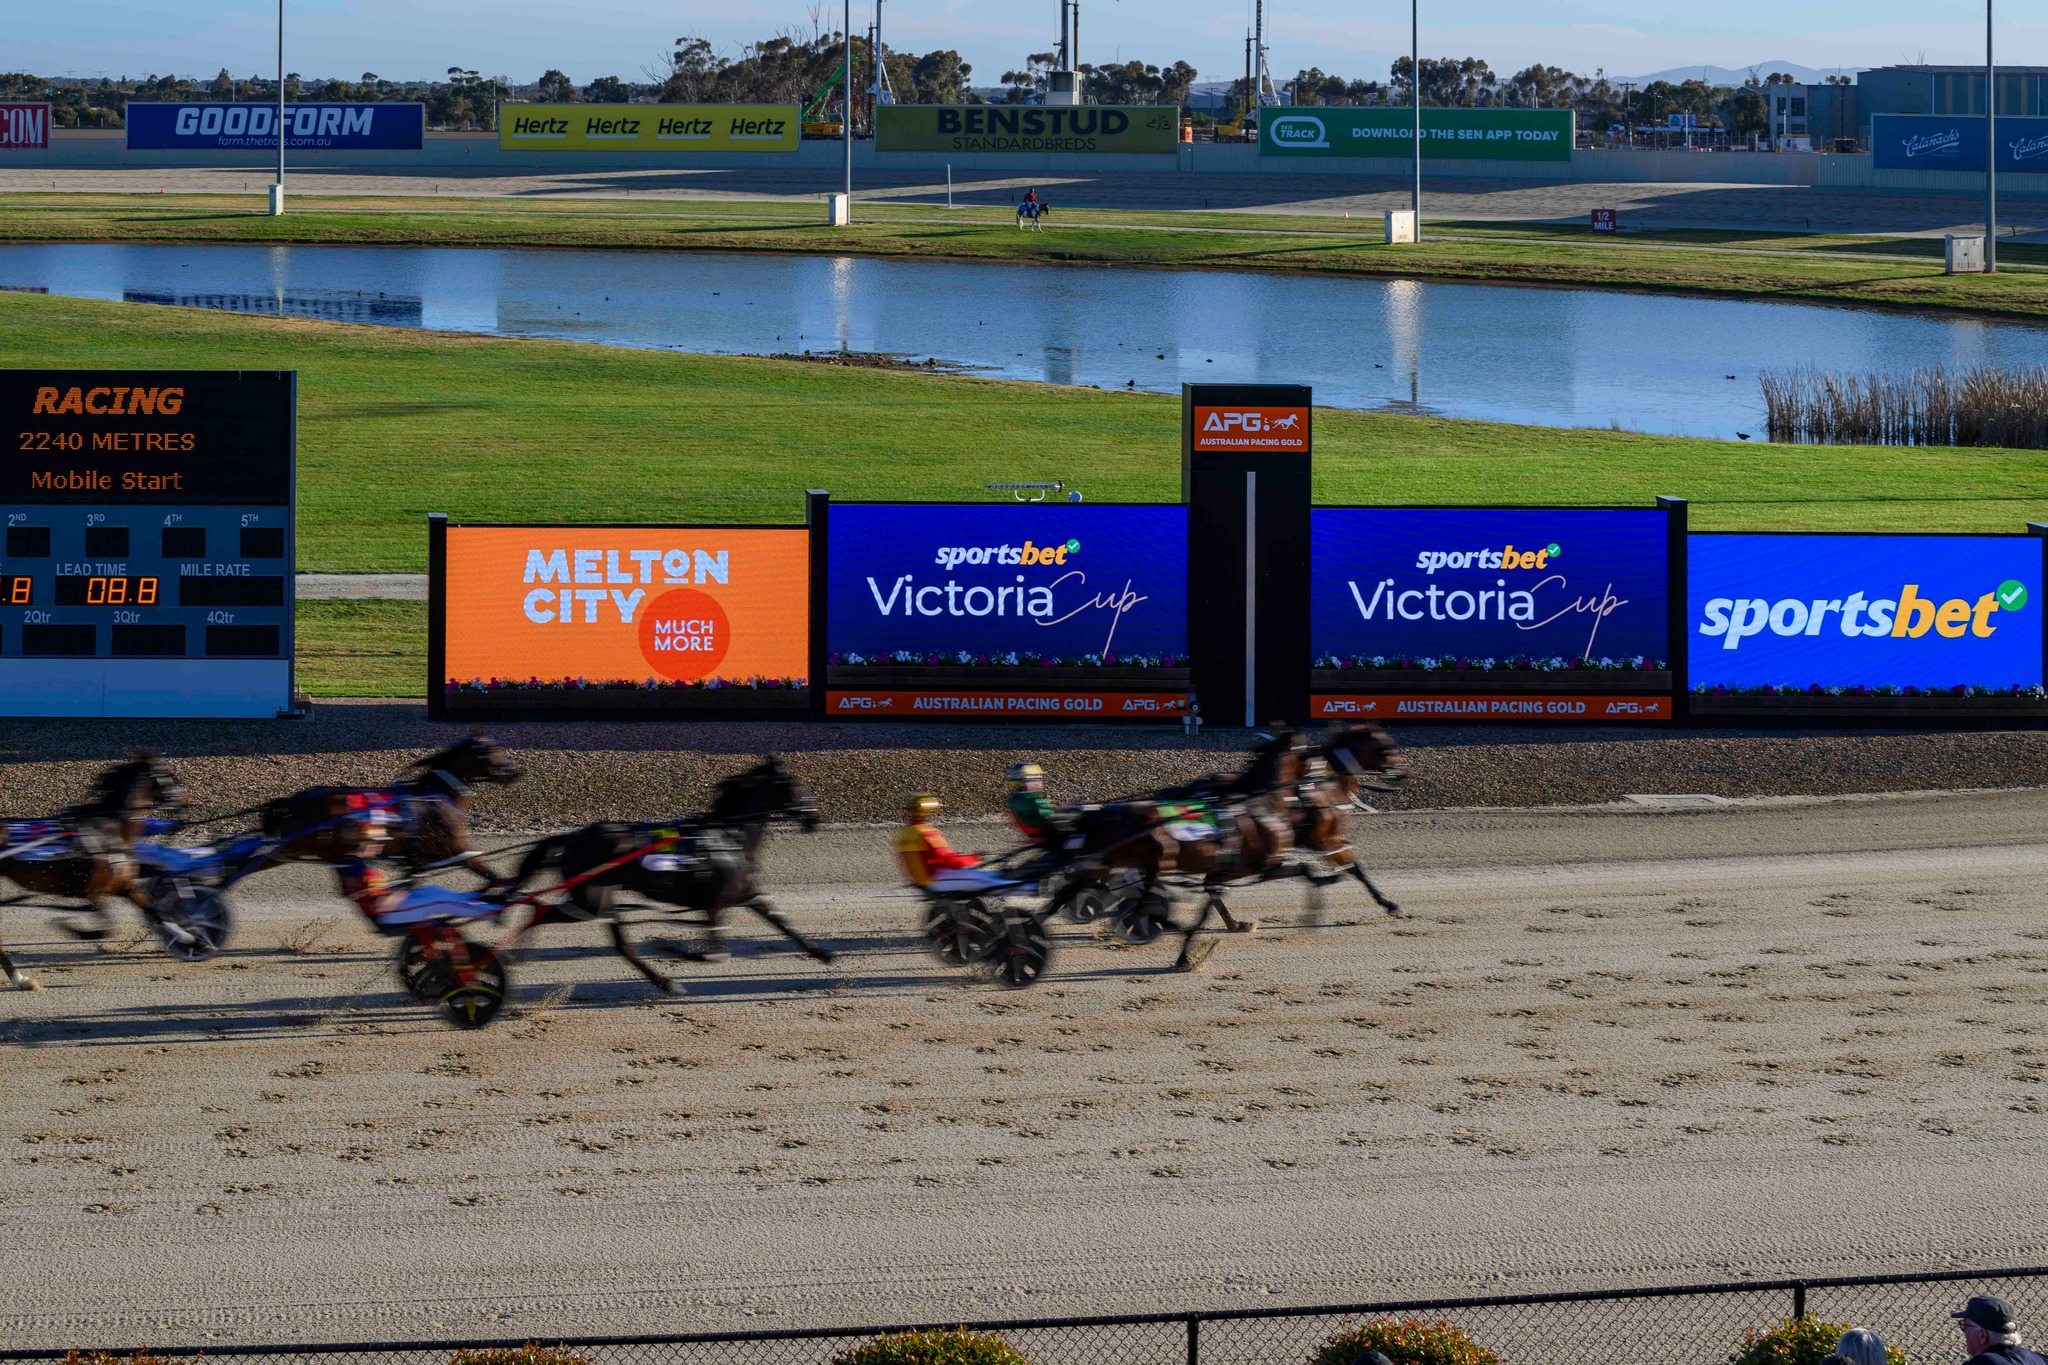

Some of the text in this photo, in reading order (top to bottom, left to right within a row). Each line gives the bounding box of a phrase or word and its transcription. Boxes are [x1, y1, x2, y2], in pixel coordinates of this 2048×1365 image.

[175, 107, 375, 136] GOODFORM
[513, 117, 786, 136] Hertz Hertz Hertz Hertz
[937, 109, 1129, 135] BENSTUD
[217, 136, 332, 147] form.thetros.com.au
[1280, 129, 1316, 139] TRACK
[1430, 129, 1455, 139] THE
[1457, 129, 1483, 140] SEN
[1485, 130, 1512, 141] APP
[1515, 130, 1559, 142] TODAY
[952, 136, 1097, 151] STANDARDBREDS
[1597, 211, 1610, 222] 1/2
[1594, 221, 1614, 230] MILE
[33, 387, 184, 414] RACING
[1203, 412, 1262, 432] APG
[19, 432, 195, 451] 2240 METRES
[1200, 438, 1303, 446] AUSTRALIAN PACING GOLD
[31, 471, 184, 490] Mobile Start
[8, 513, 27, 527] 2ND
[86, 514, 106, 527] 3RD
[164, 514, 182, 527] 4TH
[241, 514, 259, 527] 5TH
[935, 541, 1068, 570] sportsbet
[1416, 545, 1549, 574] sportsbet
[56, 563, 127, 576] LEAD TIME
[180, 563, 251, 577] MILE RATE
[523, 549, 729, 585] MELTON
[87, 577, 158, 604] 08.8
[523, 588, 646, 624] CITY
[24, 611, 52, 624] 2Qtr
[113, 611, 141, 624] 3Qtr
[207, 611, 235, 624] 4Qtr
[866, 570, 1149, 661] Victoria Cup
[1347, 575, 1629, 662] Victoria Cup
[1699, 584, 2000, 650] sportsbet
[655, 619, 714, 635] MUCH
[654, 636, 714, 651] MORE
[838, 697, 1156, 711] APG AUSTRALIAN PACING GOLD APG
[1323, 701, 1639, 714] APG AUSTRALIAN PACING GOLD APG
